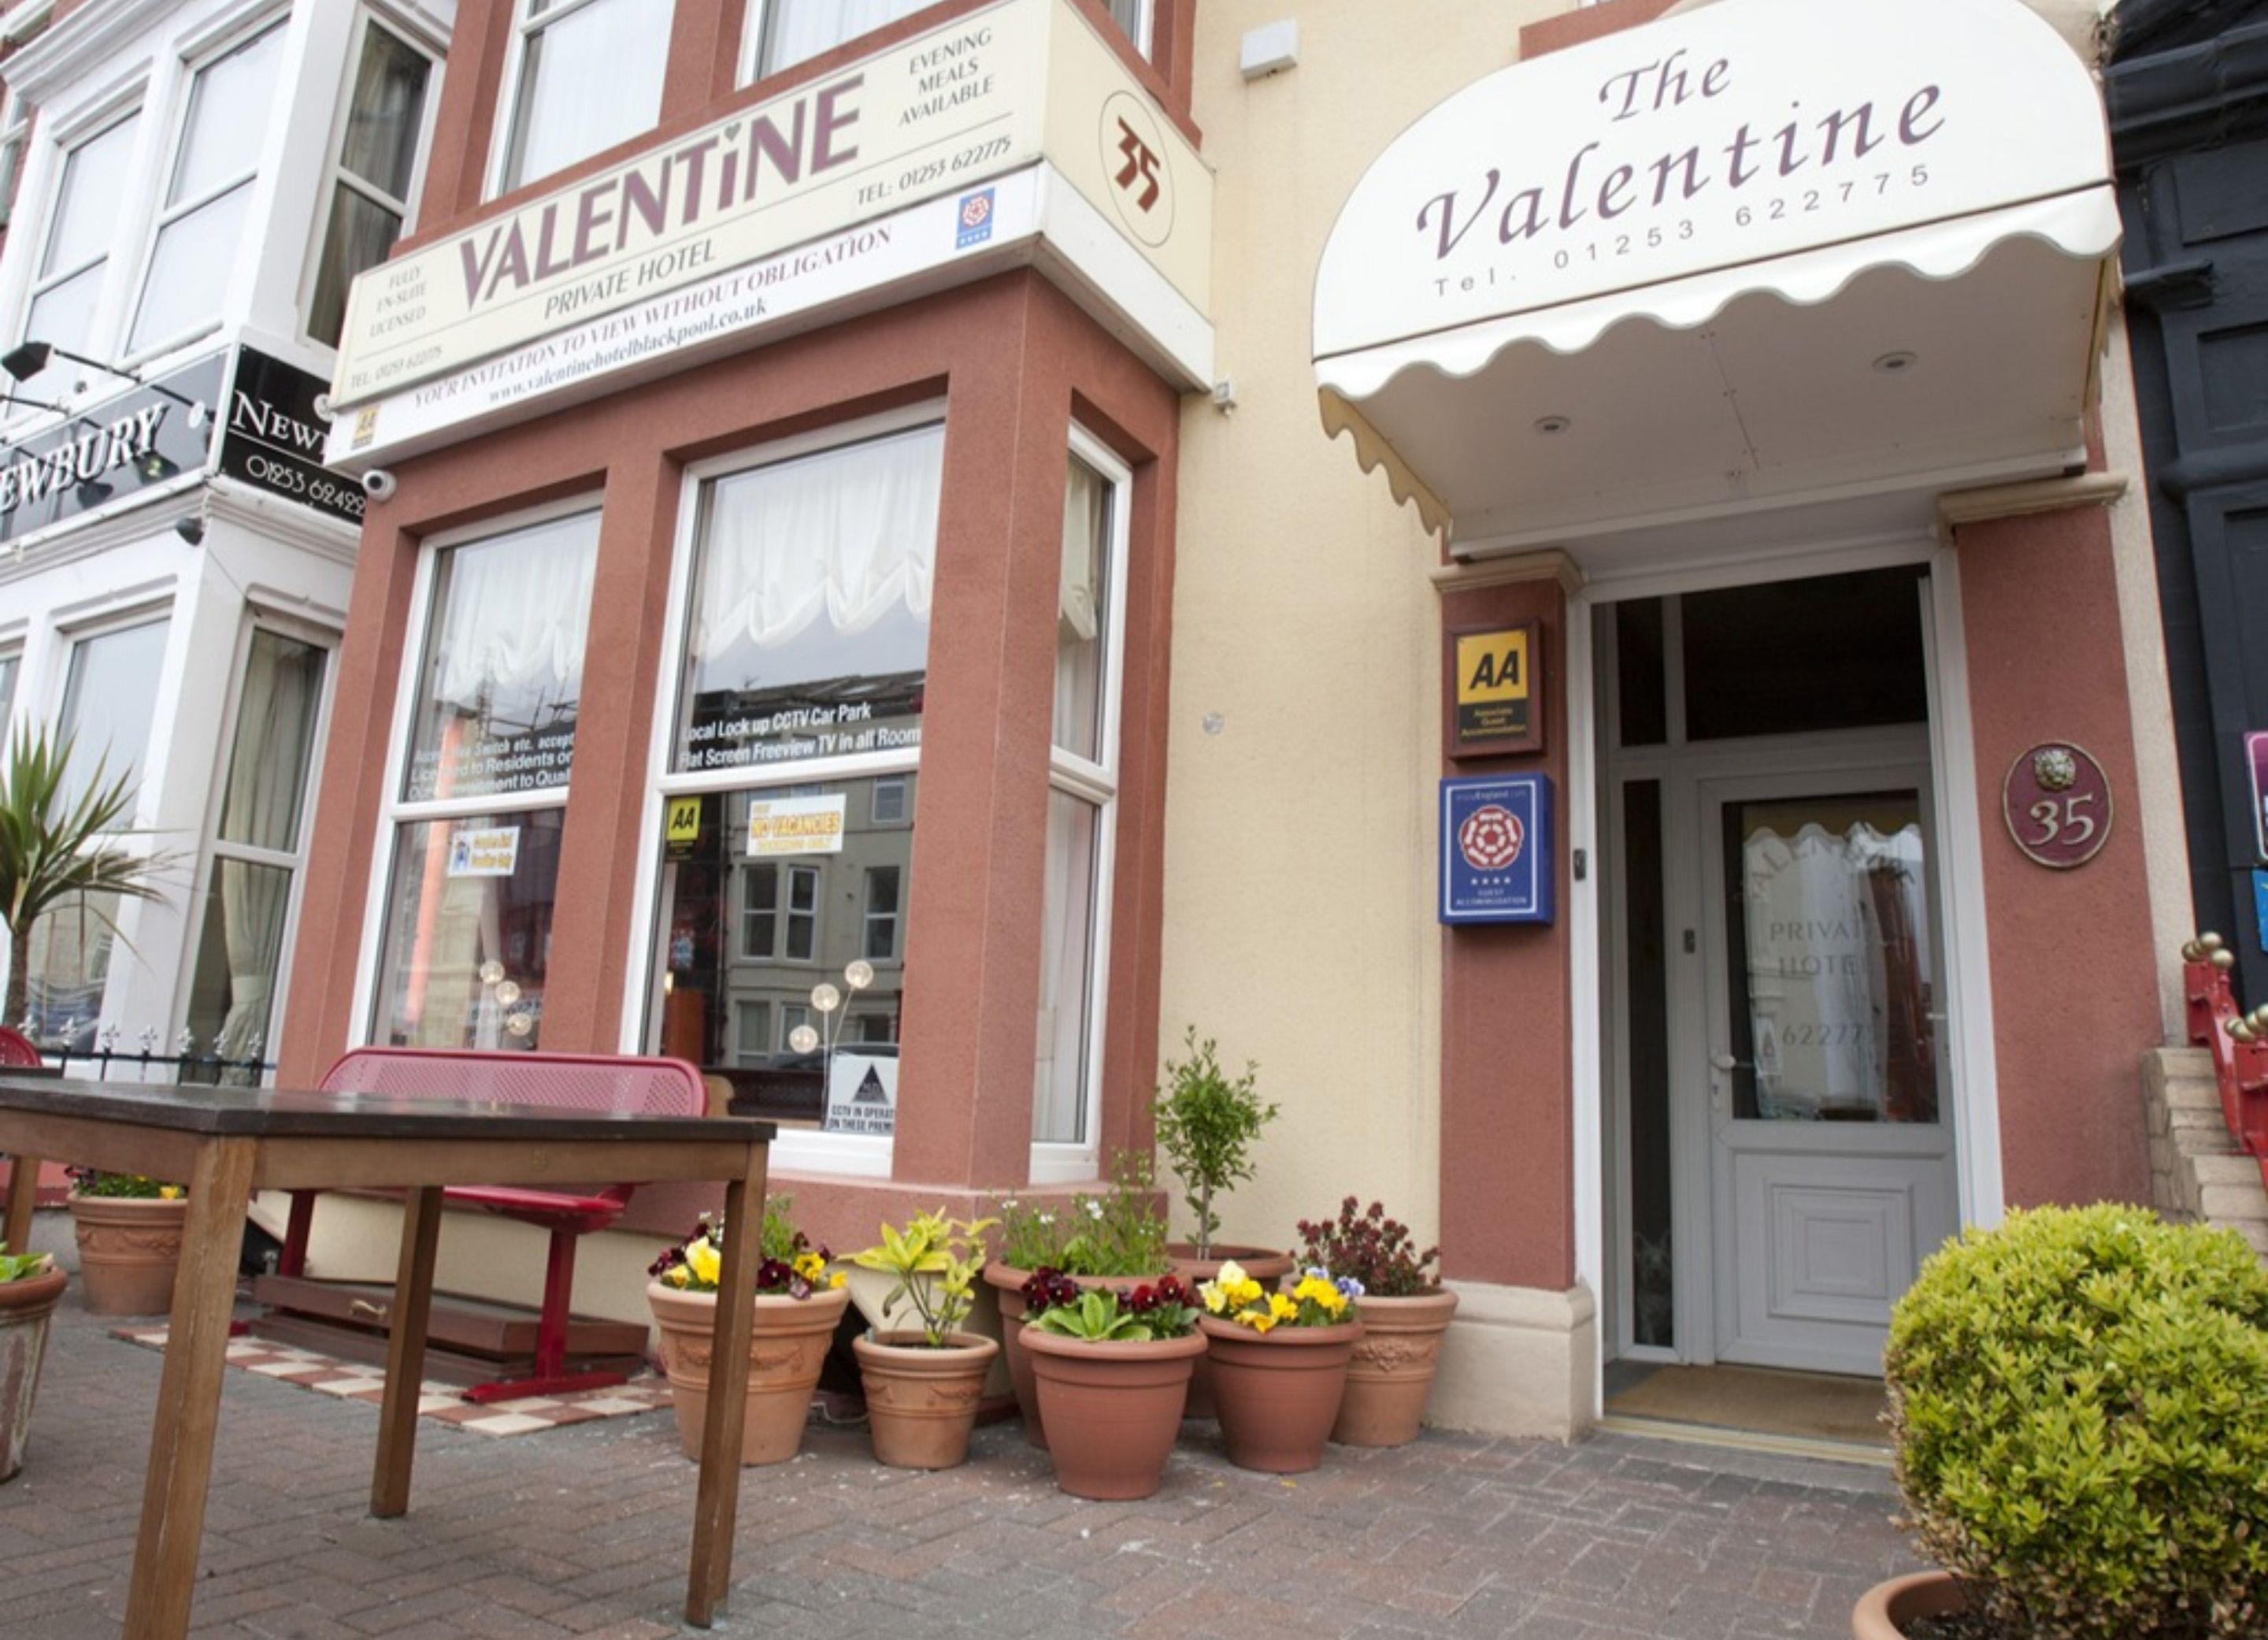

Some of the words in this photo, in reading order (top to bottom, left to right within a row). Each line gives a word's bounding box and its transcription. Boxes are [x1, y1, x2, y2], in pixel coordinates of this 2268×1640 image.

[910, 27, 992, 75] EVENING
[917, 58, 979, 95] MEALS
[1599, 47, 1731, 122] The
[898, 76, 994, 127] AVAILABLE
[858, 182, 893, 205] TEL:
[899, 161, 947, 191] 01253
[951, 135, 1012, 171] 622775
[1114, 116, 1161, 213] 35
[1417, 84, 1945, 260] Valentine
[1435, 267, 1517, 295] Tel.
[1554, 219, 1694, 269] 01253
[1736, 164, 1929, 227] 622775
[389, 265, 421, 288] FULLY
[544, 272, 631, 320] PRIVATE
[637, 239, 716, 287] HOTEL
[369, 306, 427, 338] LICENSED
[415, 380, 458, 408] YOUR
[461, 343, 556, 391] INVITATION
[562, 334, 585, 355] TO
[590, 315, 637, 346] VIEW
[644, 276, 744, 328] WITHOUT
[747, 224, 893, 291] OBLIGATION
[489, 297, 768, 403] www.valentinehotelblackpool.co.uk
[230, 389, 327, 456] NEW
[246, 455, 306, 493] 01253
[1469, 648, 1520, 691] AA
[717, 717, 749, 737] Lock
[752, 718, 769, 737] up
[772, 708, 810, 730] CCTV
[810, 706, 836, 725] Car
[838, 701, 872, 722] Park
[485, 751, 555, 775] Residents
[705, 747, 751, 767] Screen
[753, 739, 816, 761] Freeview
[818, 733, 837, 756] TV
[839, 732, 854, 751] in
[856, 728, 876, 748] all
[520, 774, 535, 788] to
[670, 805, 695, 831] AA
[2027, 792, 2096, 845] 35
[1770, 920, 1863, 941] PRIVAT
[1778, 954, 1856, 978] HOTE
[1781, 1024, 1863, 1048] 62277
[832, 1104, 851, 1117] CCTV
